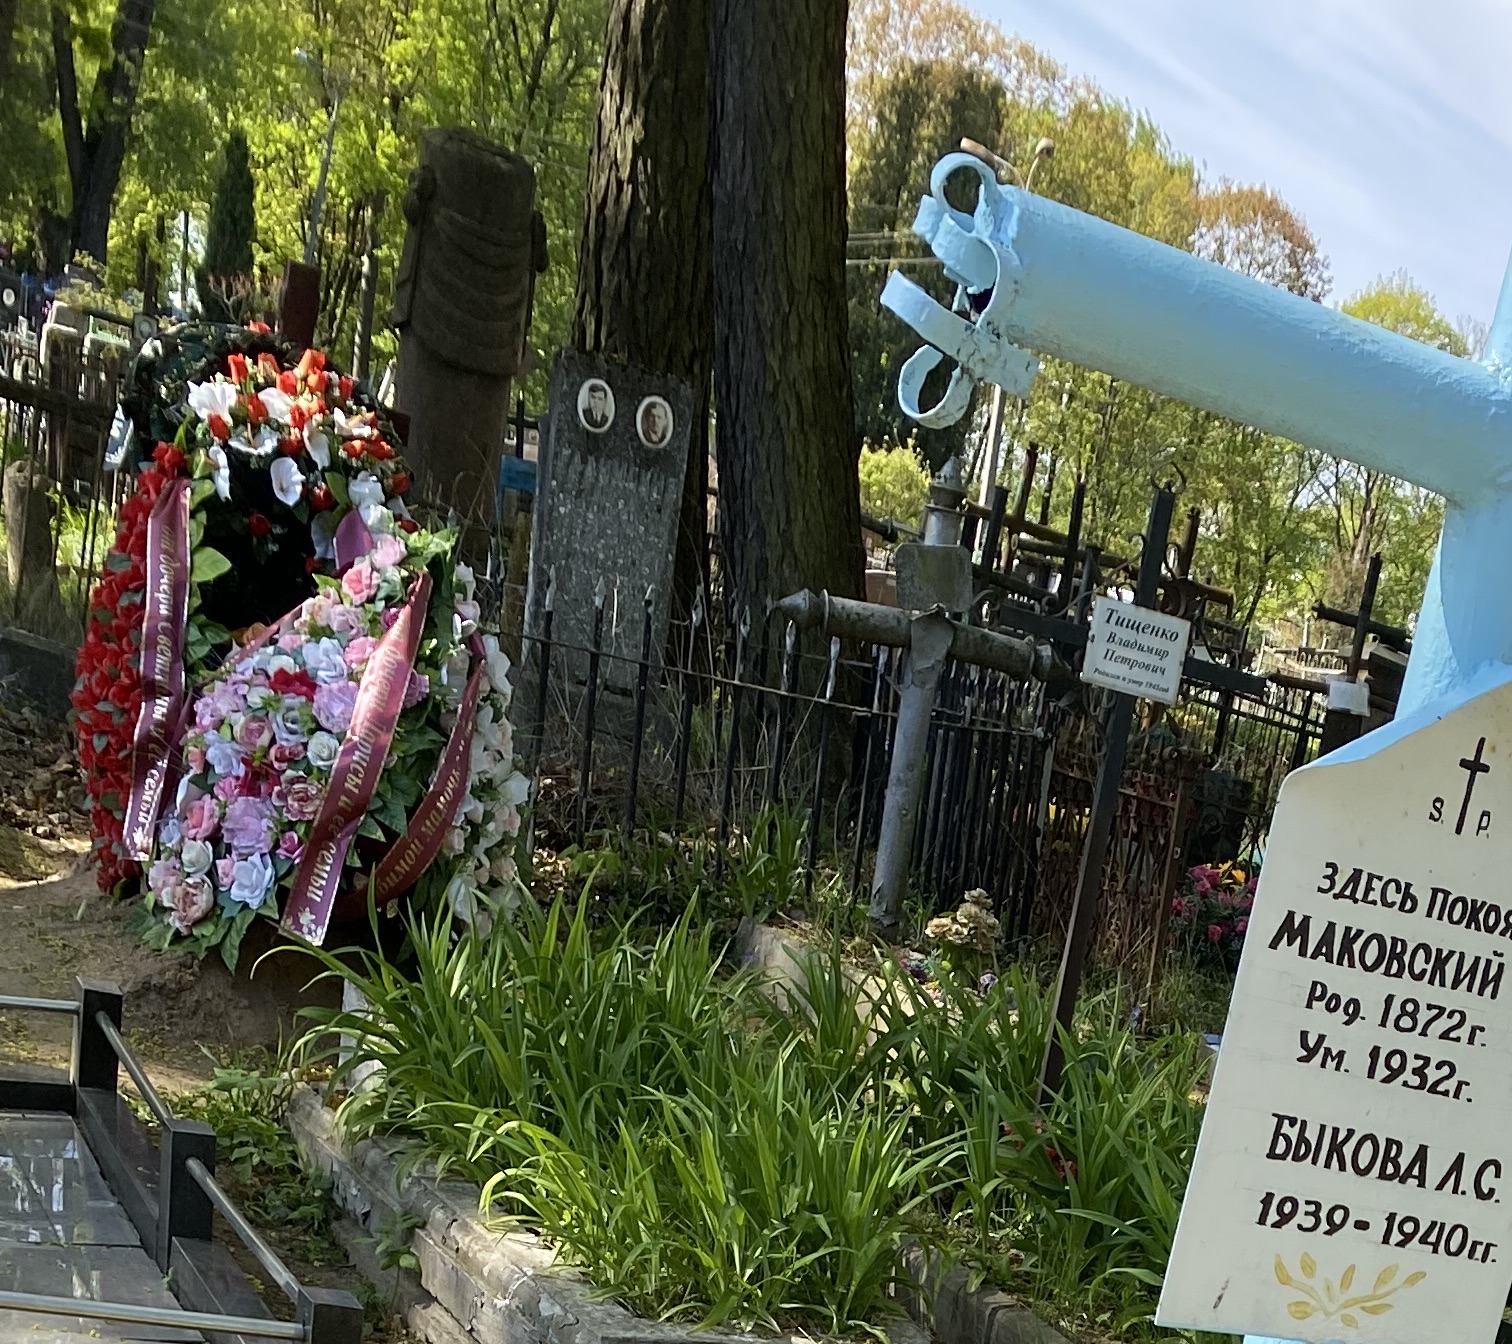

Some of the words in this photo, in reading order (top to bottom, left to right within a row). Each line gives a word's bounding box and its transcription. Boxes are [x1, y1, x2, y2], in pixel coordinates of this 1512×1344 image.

[158, 553, 182, 616] дочери
[1104, 607, 1180, 643] Тищенко
[1105, 630, 1171, 662] Владимир
[1102, 647, 1168, 676] Петрович
[138, 769, 162, 827] семьи
[337, 793, 355, 814] и
[306, 840, 339, 904] семьи
[1316, 861, 1419, 914] ЗДЕСЬ
[1267, 909, 1506, 1001] МАКОВСКИЙ
[1265, 1112, 1430, 1189] БЫКОВА
[1434, 1151, 1502, 1204] Л.С.
